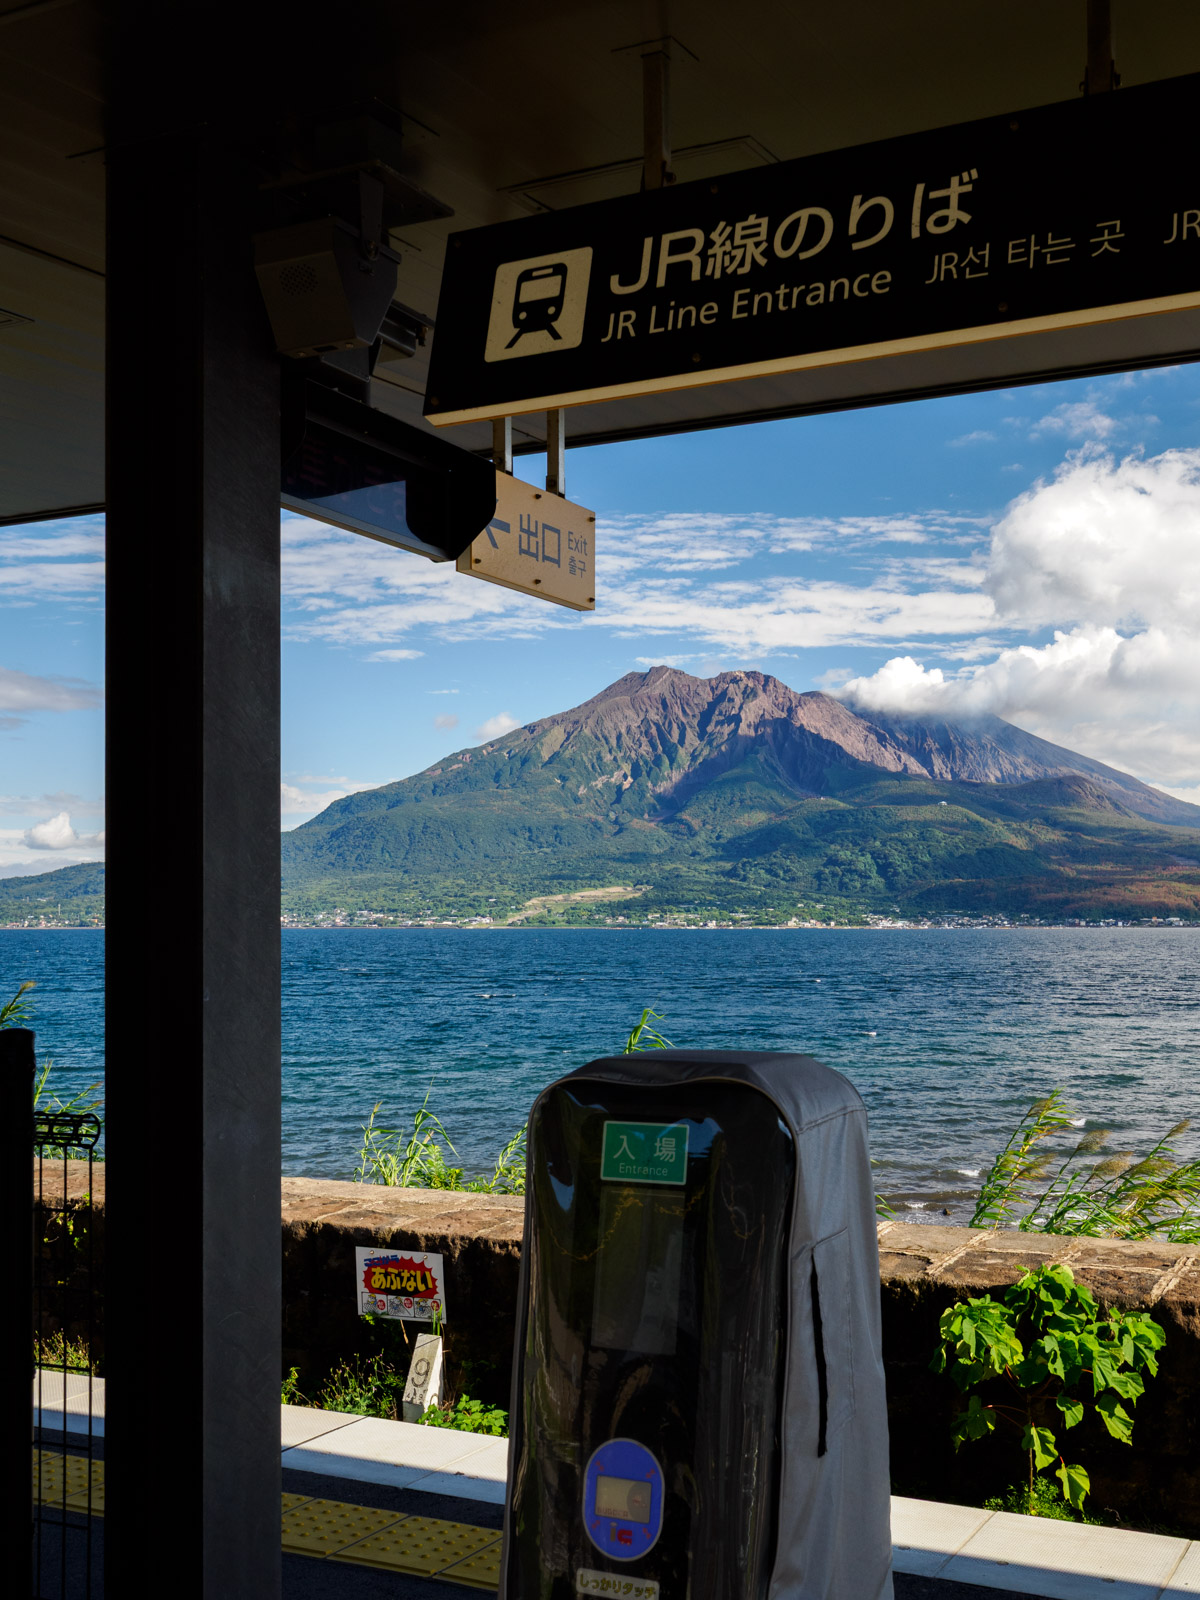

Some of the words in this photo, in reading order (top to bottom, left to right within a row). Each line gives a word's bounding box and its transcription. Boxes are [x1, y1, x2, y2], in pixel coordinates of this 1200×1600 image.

[609, 167, 980, 297] JR線のりば
[925, 242, 990, 285] JR선
[1007, 231, 1077, 270] 타는
[1089, 219, 1126, 258] 곳
[601, 309, 637, 343] JR
[649, 300, 718, 334] Line
[731, 269, 892, 320] Entrance
[519, 514, 561, 569] 出口
[568, 531, 588, 557] Exit
[568, 556, 587, 579] 출구
[613, 1135, 677, 1163] 入場
[619, 1163, 668, 1177] Entrance
[363, 1254, 400, 1268] ここから
[370, 1267, 433, 1293] あぶない
[579, 1573, 656, 1600] しっかりタッチ
